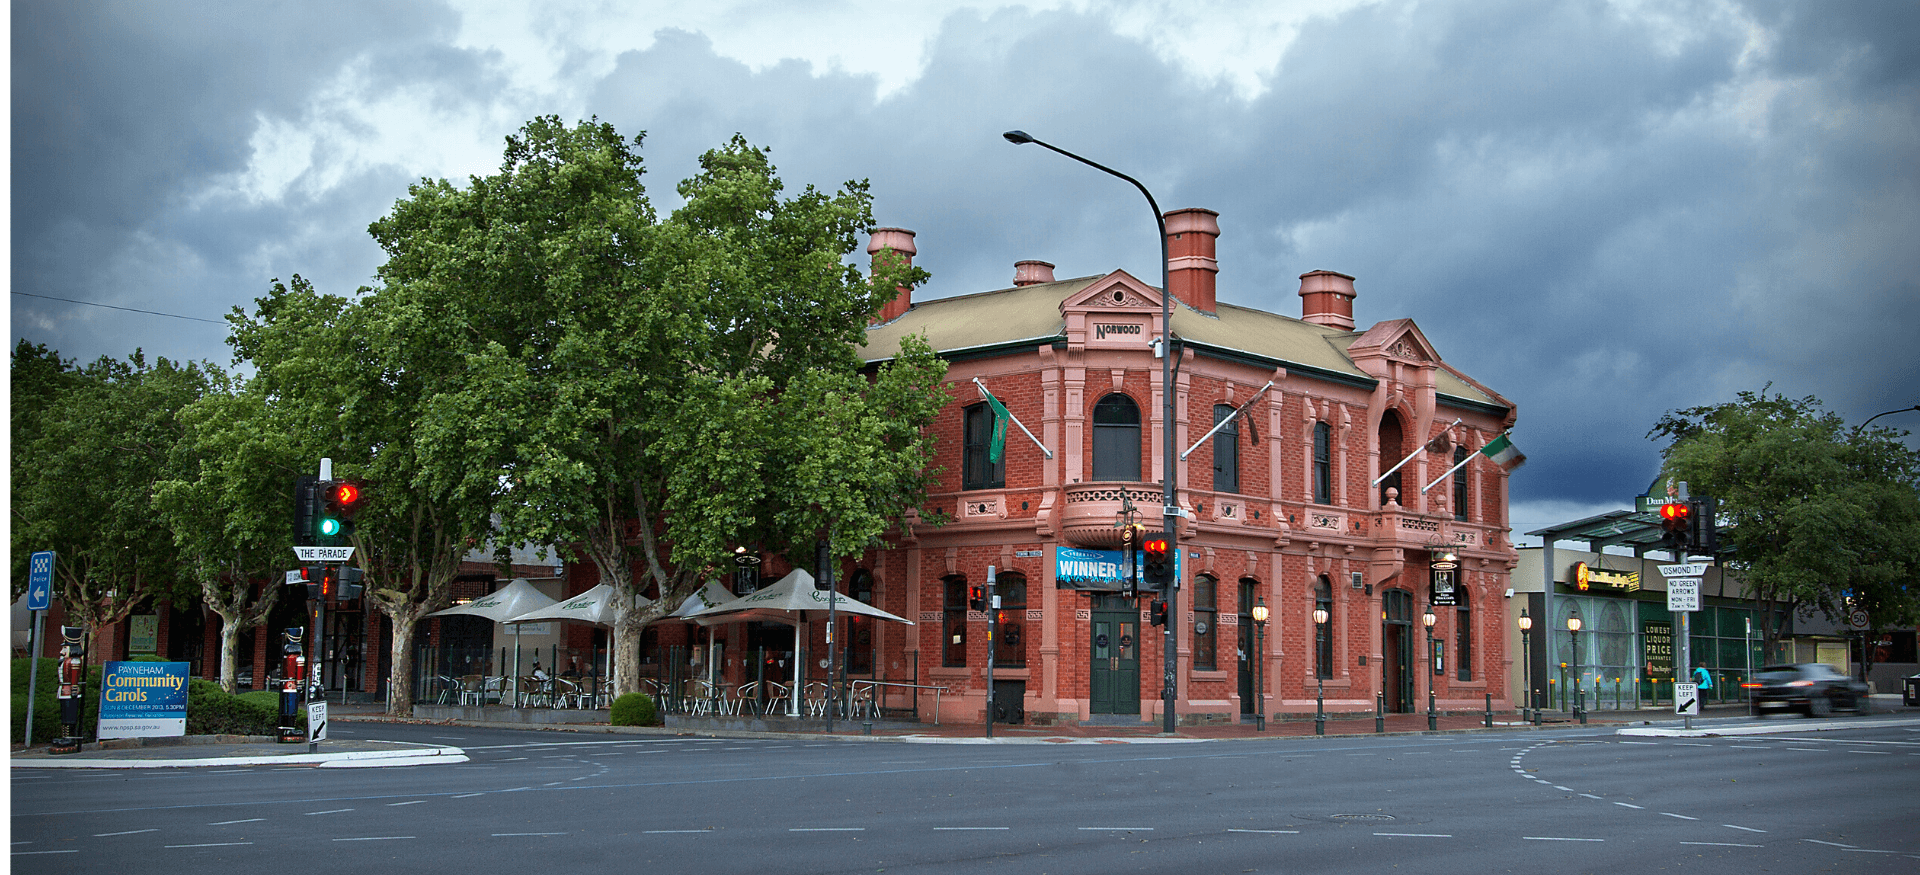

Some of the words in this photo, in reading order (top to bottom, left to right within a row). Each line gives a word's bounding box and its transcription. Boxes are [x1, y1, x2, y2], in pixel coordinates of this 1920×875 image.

[1646, 497, 1664, 505] Dan
[301, 549, 315, 558] THE
[318, 549, 347, 558] PARADE
[1060, 560, 1117, 578] WINNER
[1663, 566, 1691, 575] OSMOND
[1853, 614, 1866, 623] 50
[1645, 626, 1670, 634] LOWEST
[1646, 635, 1671, 644] LIQUOR
[1646, 645, 1671, 654] PRICE
[118, 666, 164, 674] PAYNEHAM
[106, 673, 184, 691] Community
[105, 688, 148, 702] Carols
[311, 705, 325, 713] KEEP
